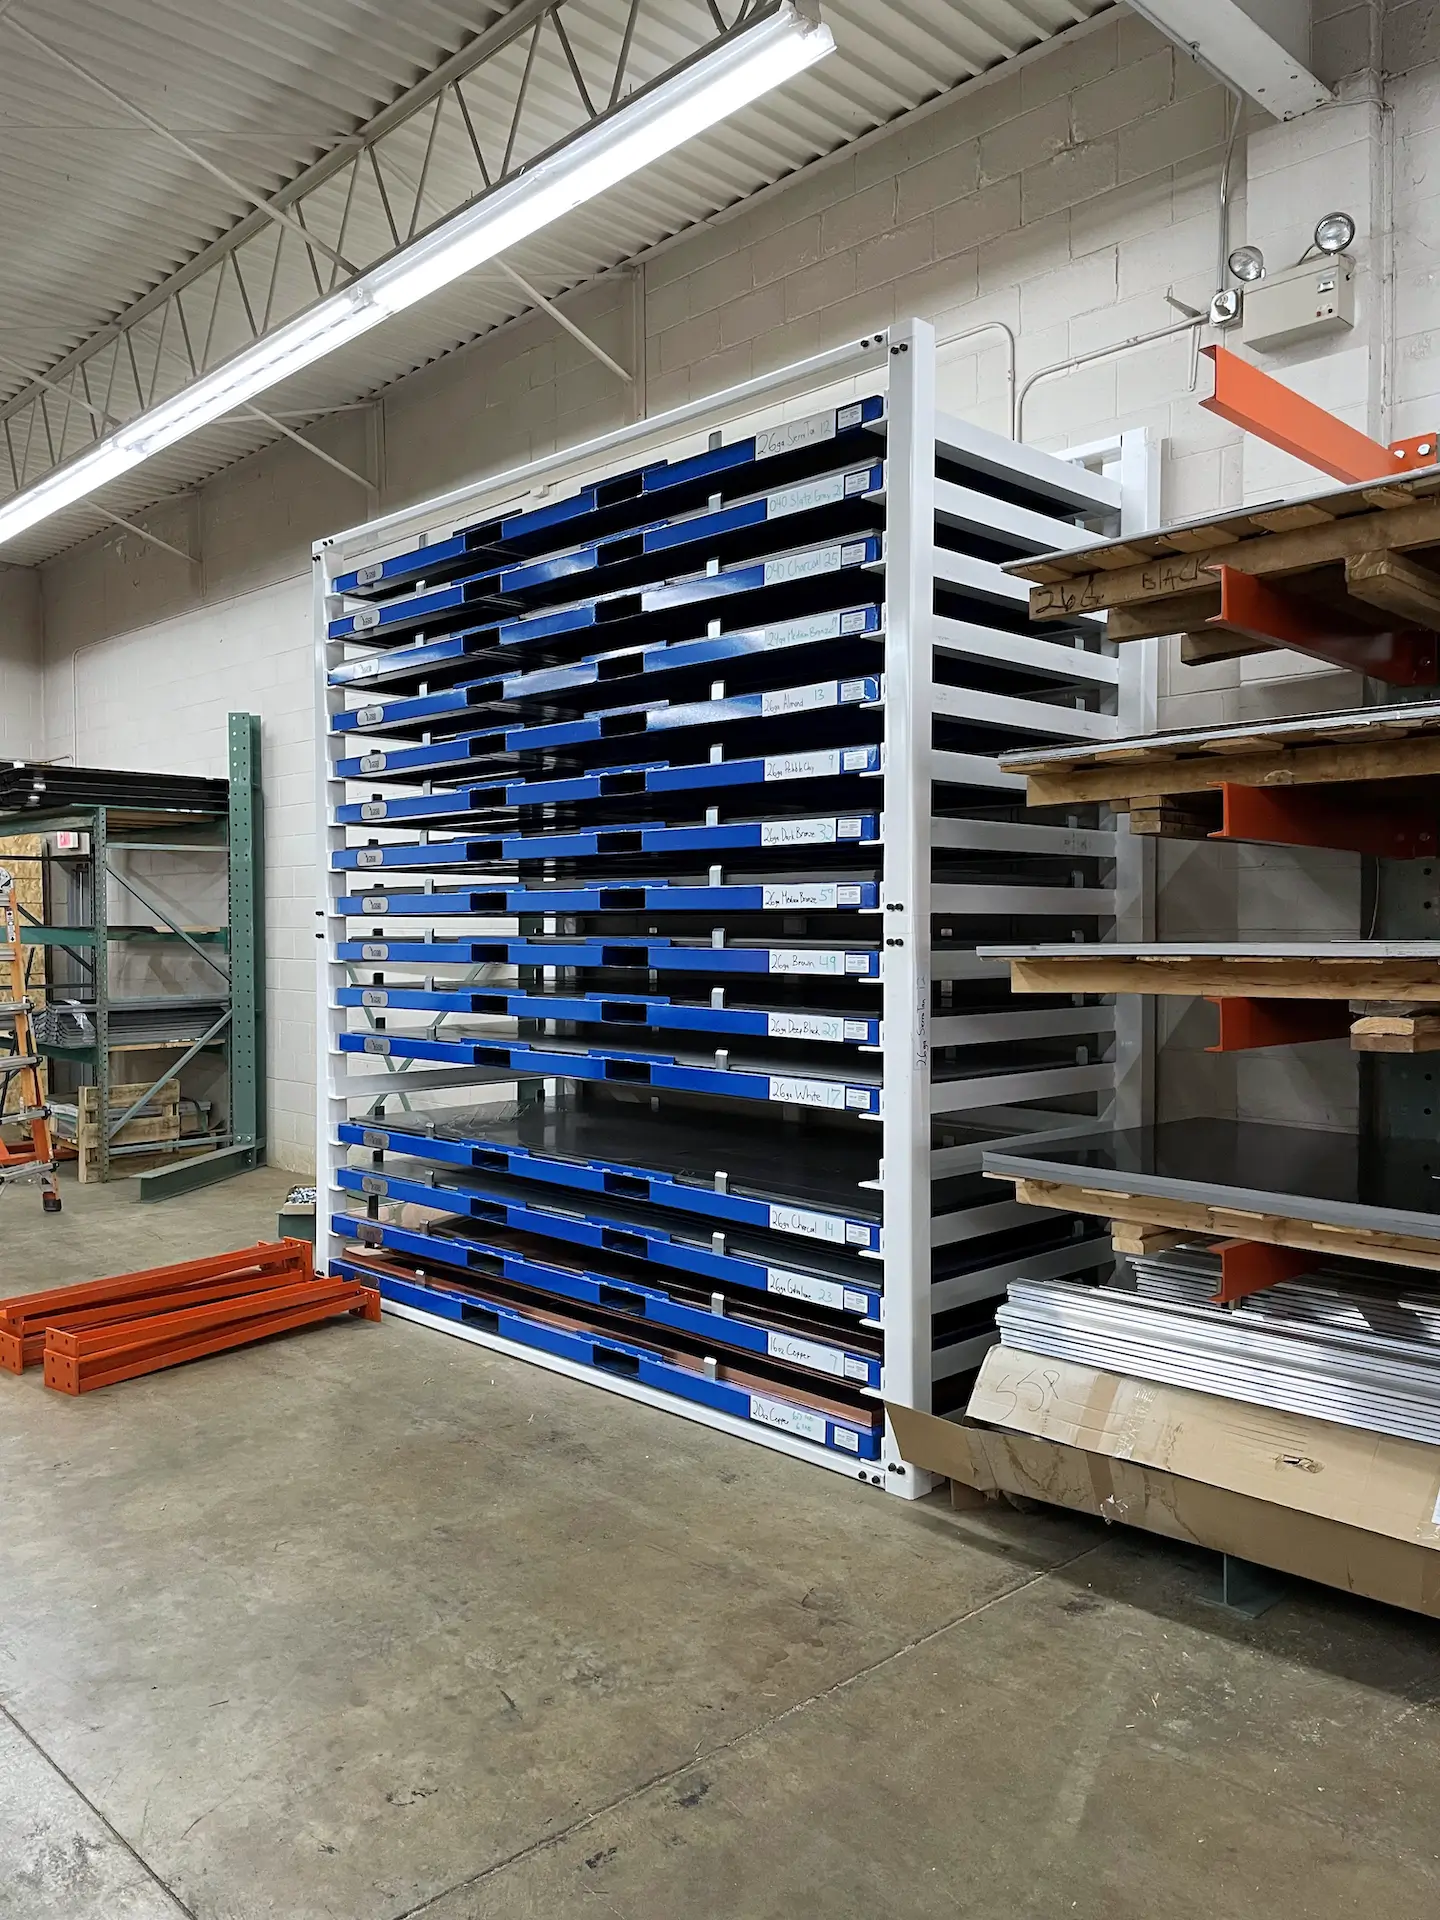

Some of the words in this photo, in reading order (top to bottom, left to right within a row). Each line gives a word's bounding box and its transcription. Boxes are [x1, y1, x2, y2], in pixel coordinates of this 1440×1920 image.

[783, 693, 804, 710] Almond
[814, 688, 825, 701] 13
[828, 754, 834, 769] 9
[819, 888, 834, 902] 59
[792, 954, 815, 969] Brown
[819, 955, 836, 973] 49
[822, 1022, 839, 1039] 28
[795, 1084, 822, 1102] White
[826, 1087, 842, 1106] 17
[824, 1220, 834, 1237] 14
[818, 1288, 833, 1303] 23
